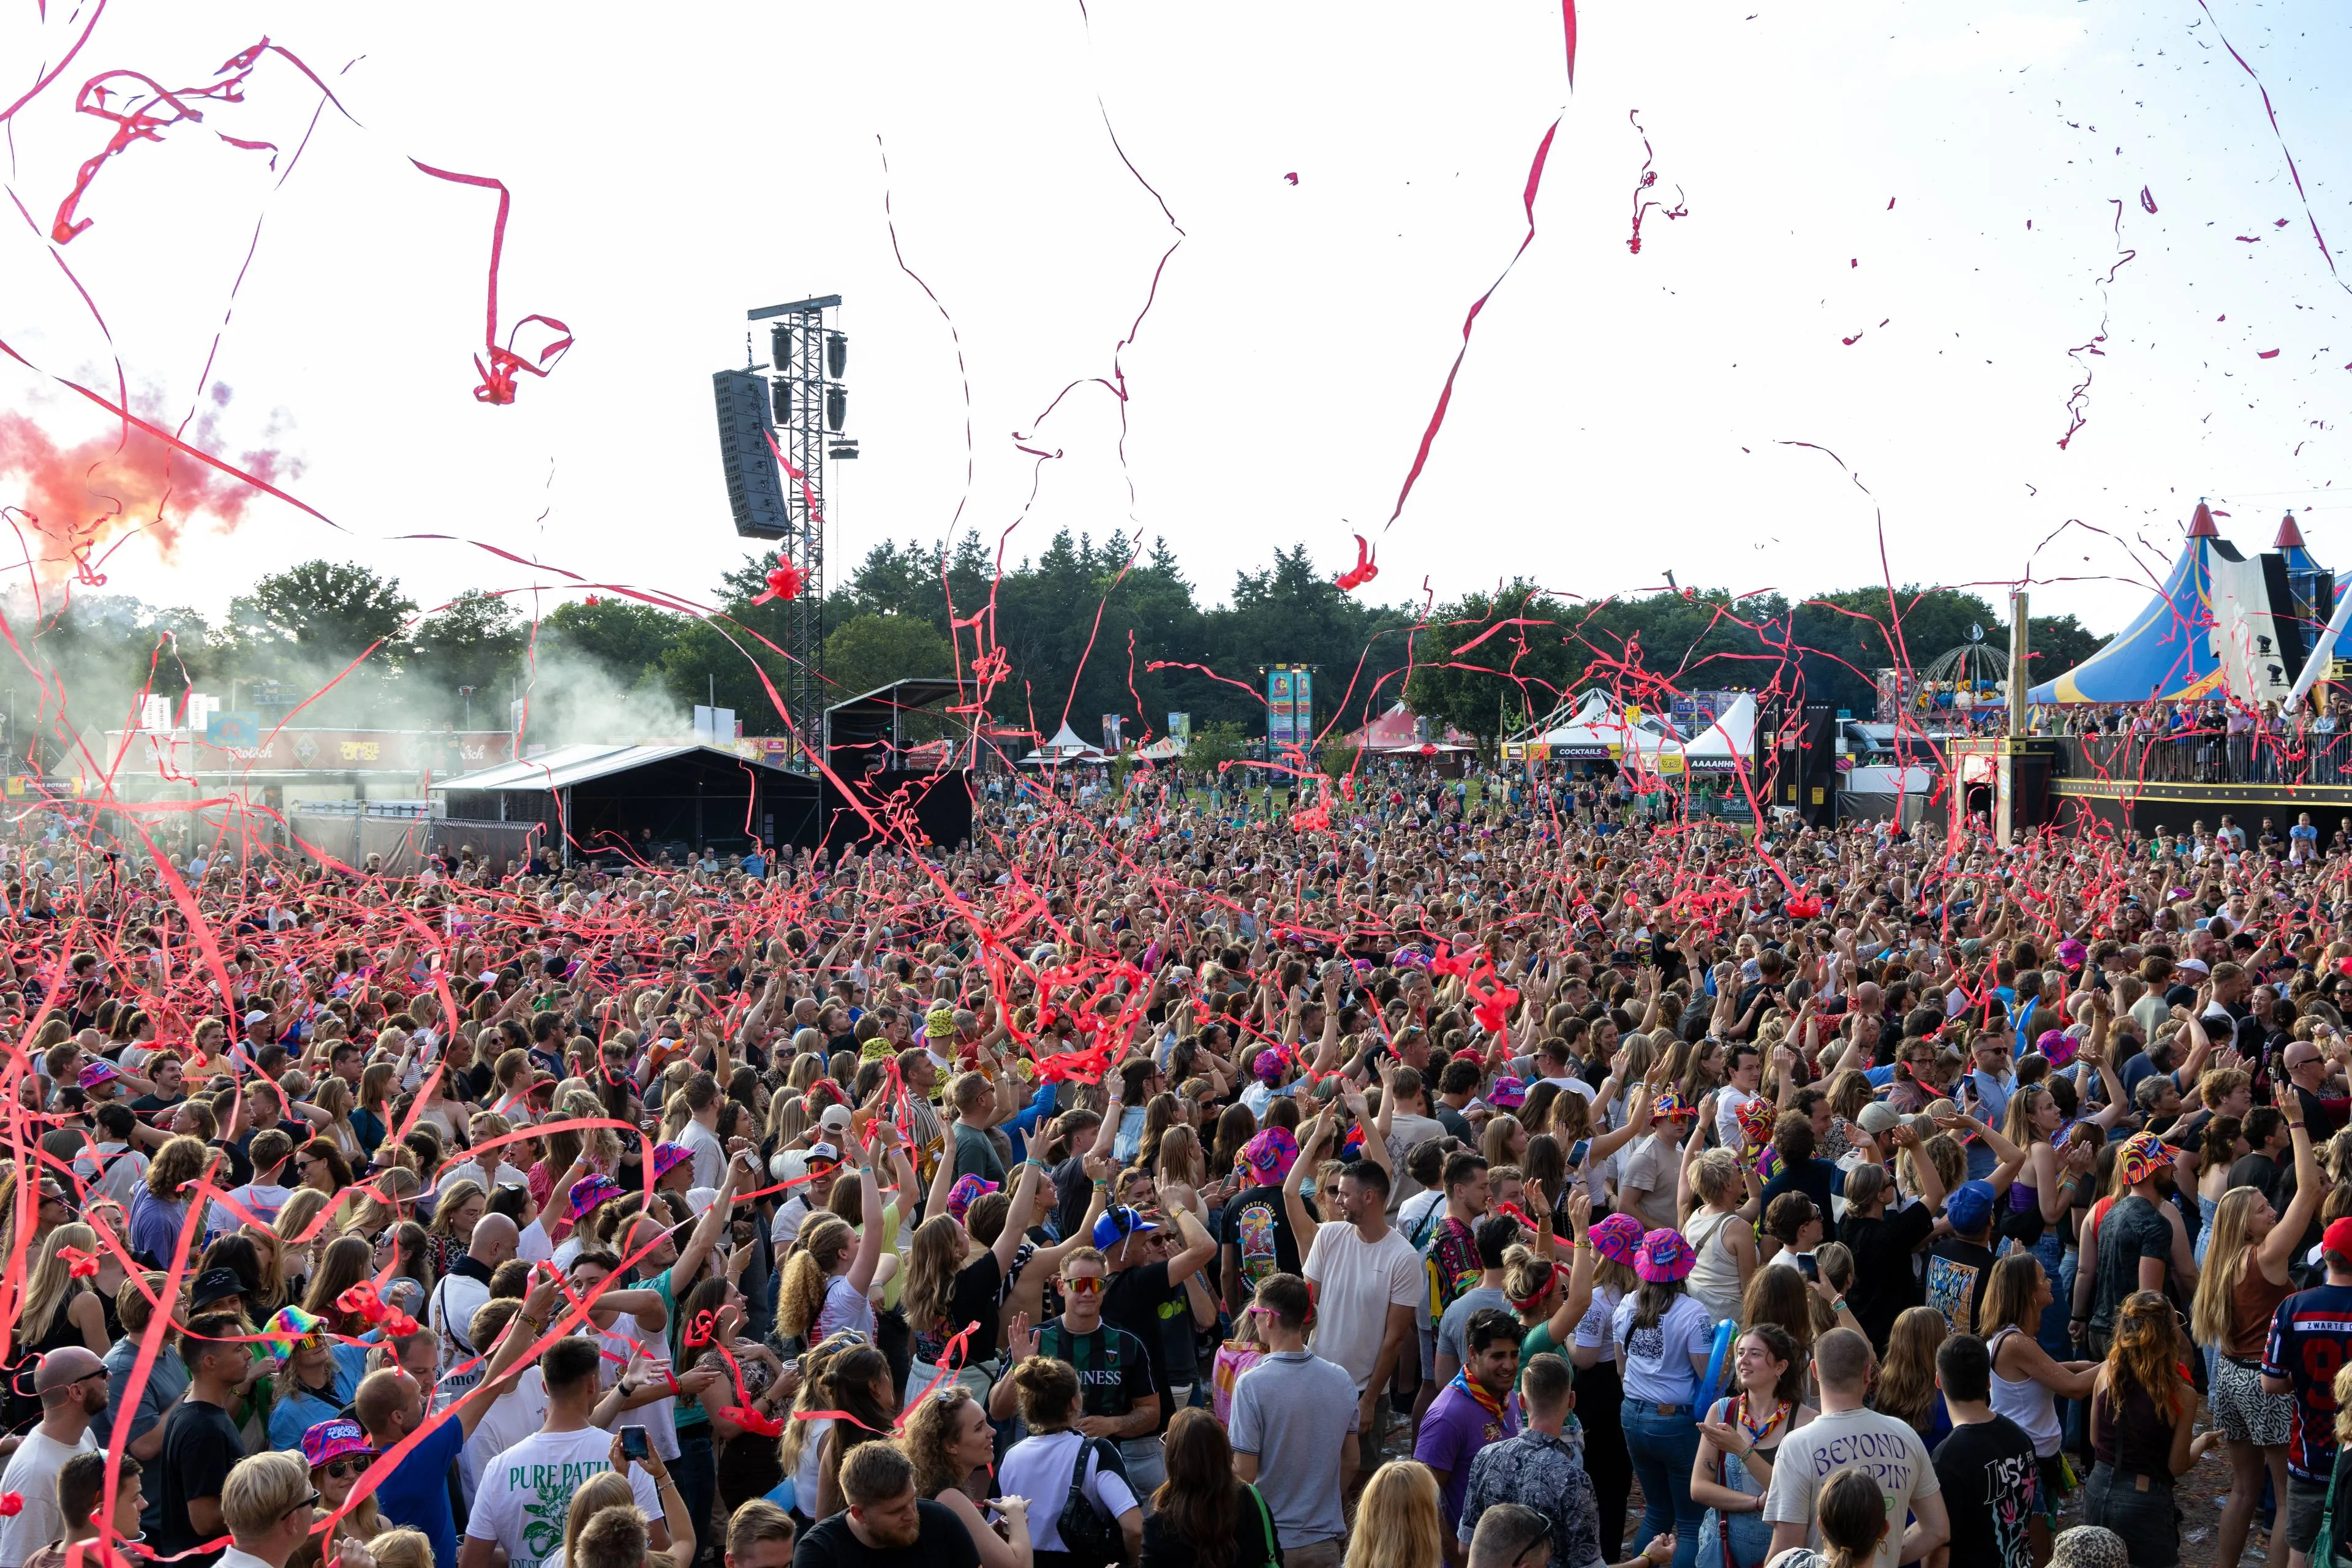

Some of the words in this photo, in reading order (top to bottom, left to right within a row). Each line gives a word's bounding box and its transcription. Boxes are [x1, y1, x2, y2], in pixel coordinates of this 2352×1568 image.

[1722, 800, 1749, 813] Grolsch
[1239, 1201, 1262, 1217] ZWARTE
[1263, 1202, 1276, 1218] CROSS
[1078, 1370, 1122, 1385] NNESS
[327, 1425, 359, 1435] ZWARTE
[330, 1430, 360, 1440] CROSS
[1813, 1433, 1906, 1477] BEYOND
[510, 1464, 558, 1491] PURE
